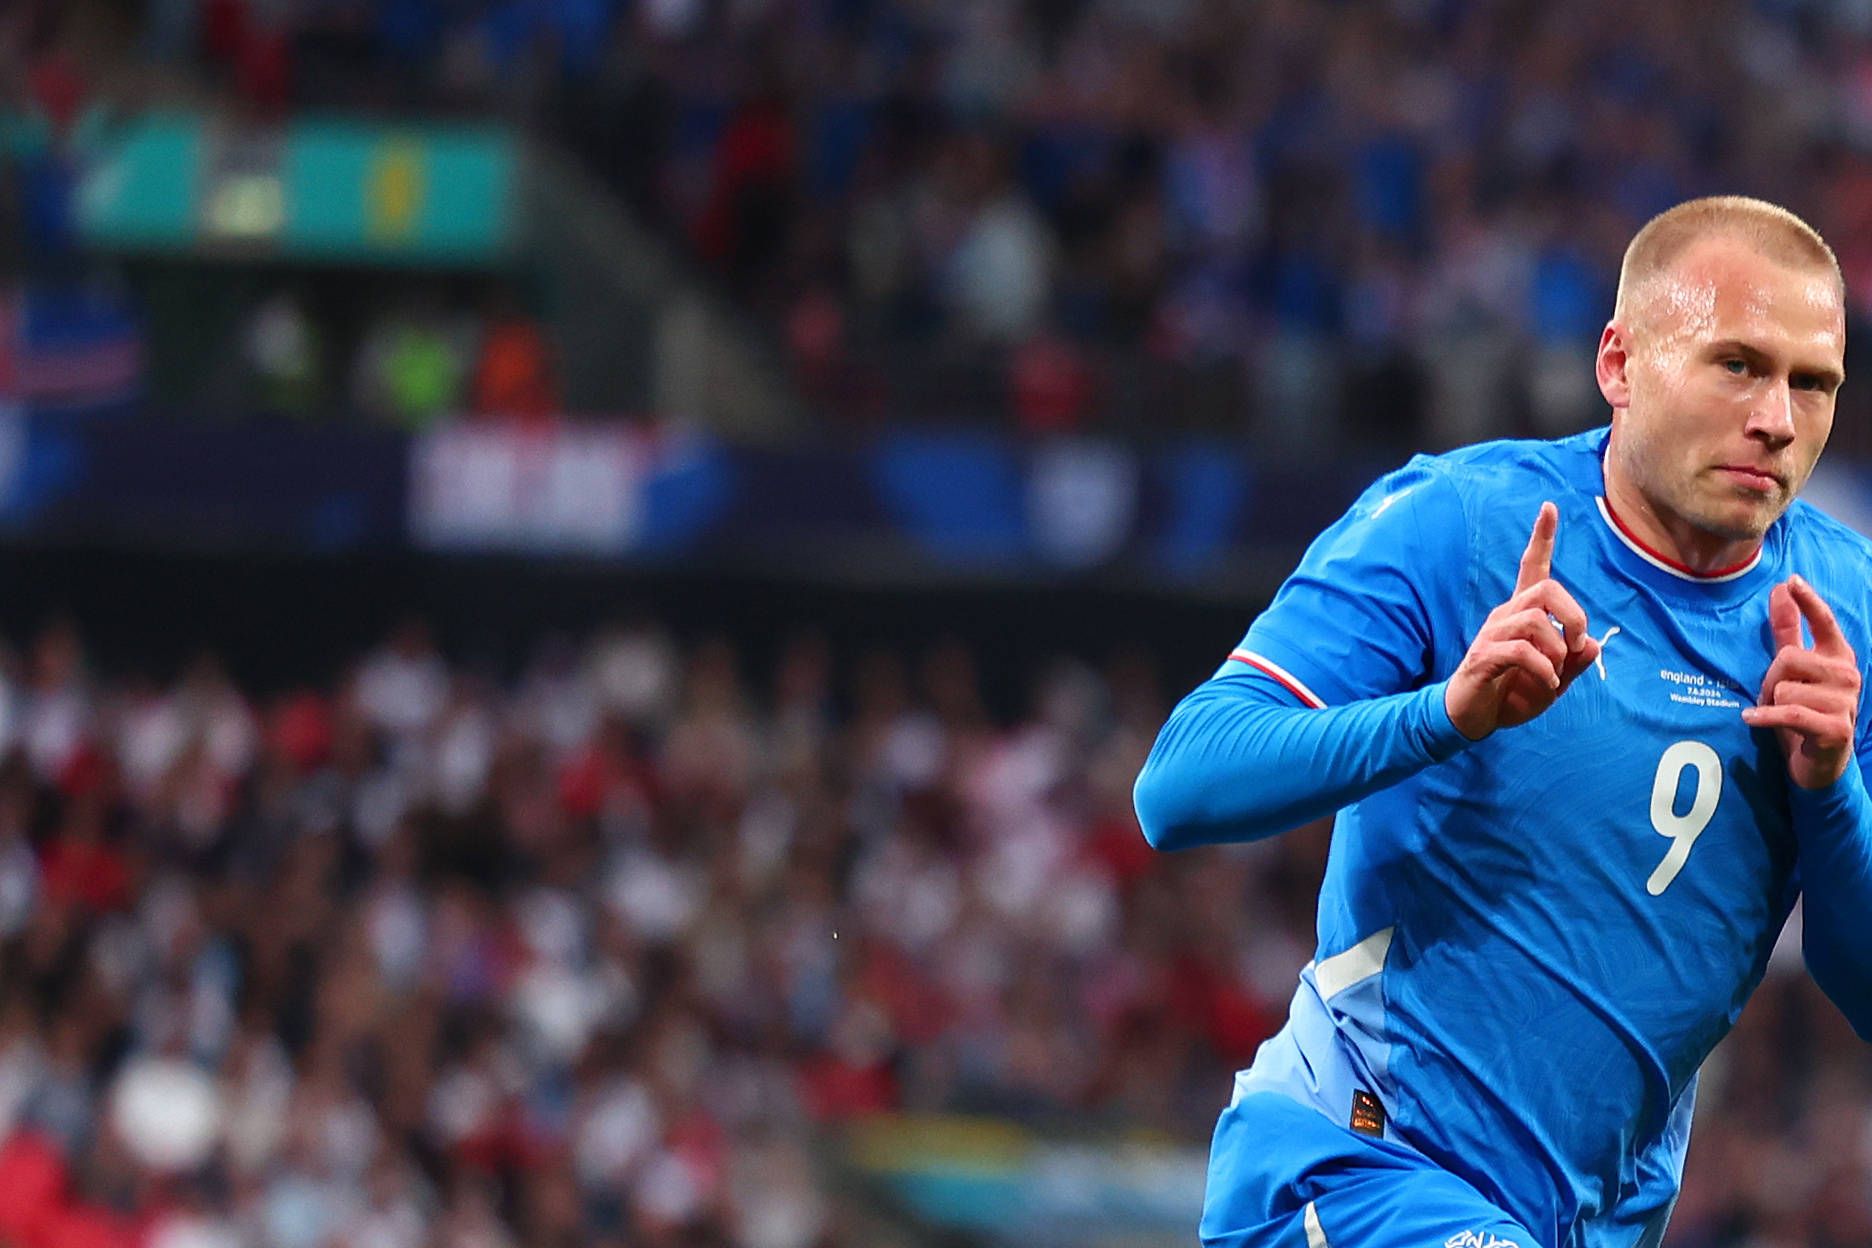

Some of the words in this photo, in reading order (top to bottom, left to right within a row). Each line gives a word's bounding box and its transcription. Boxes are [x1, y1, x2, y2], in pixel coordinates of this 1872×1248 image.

[1660, 669, 1704, 685] england
[1670, 693, 1705, 706] Wembley
[1706, 698, 1739, 708] Stadium
[1646, 740, 1722, 896] 9
